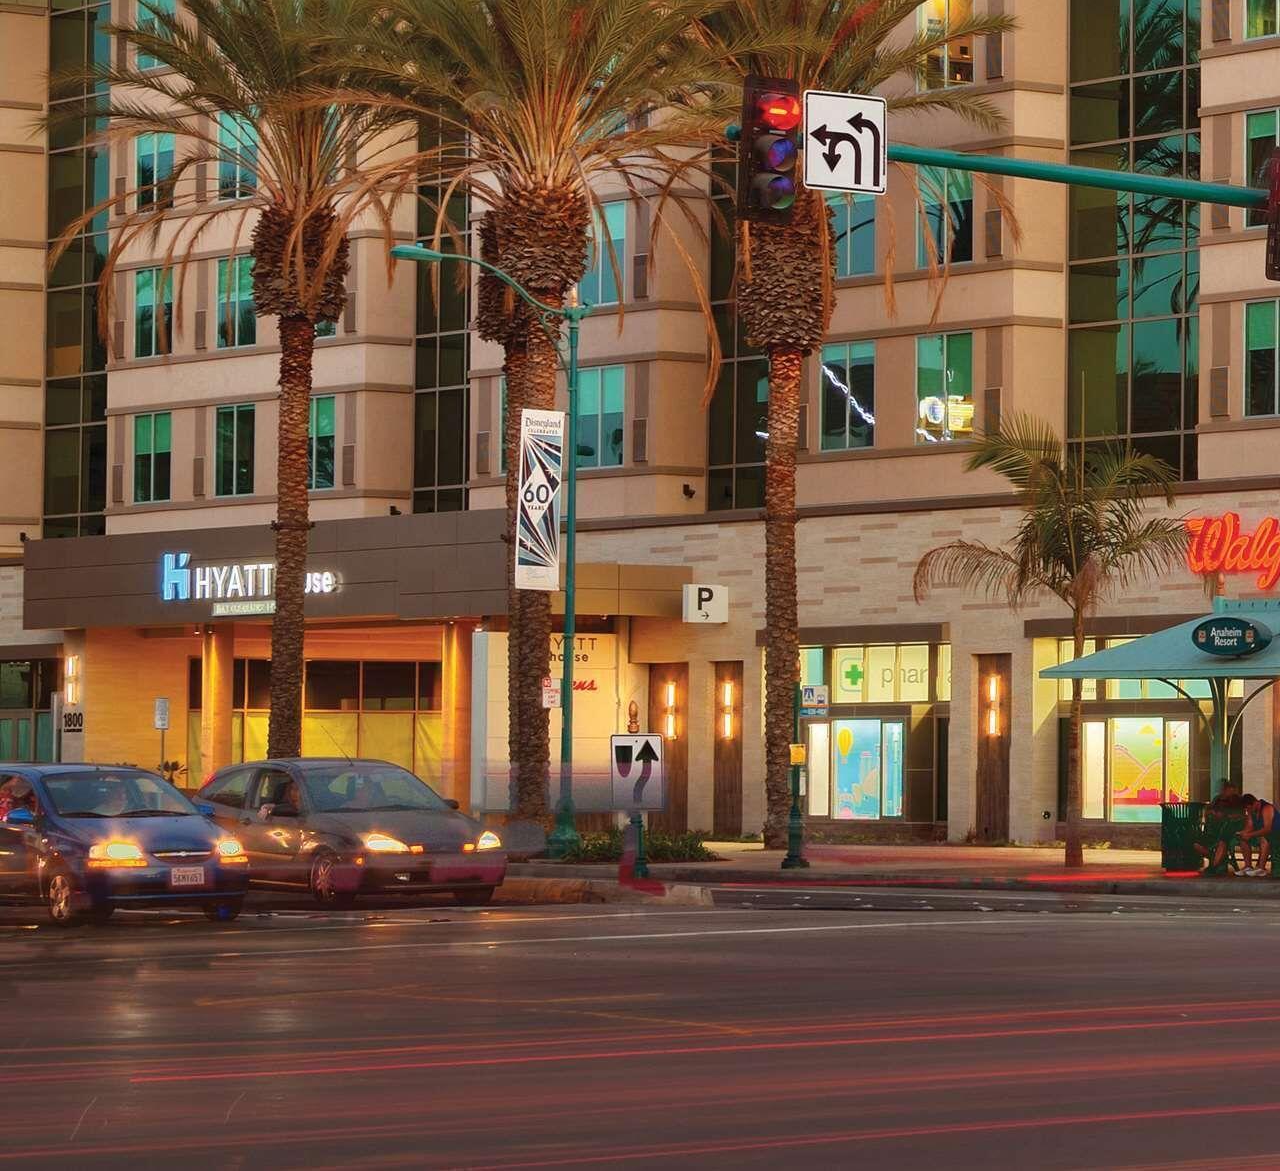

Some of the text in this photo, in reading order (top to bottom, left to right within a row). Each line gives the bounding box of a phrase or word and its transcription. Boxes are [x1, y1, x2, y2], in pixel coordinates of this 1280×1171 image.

[525, 417, 561, 429] Disneyland
[523, 483, 550, 504] 60
[195, 563, 278, 600] HYATT
[697, 587, 714, 611] P
[1210, 627, 1242, 637] Anaheim
[1214, 636, 1238, 646] Resort
[63, 712, 83, 728] 1800
